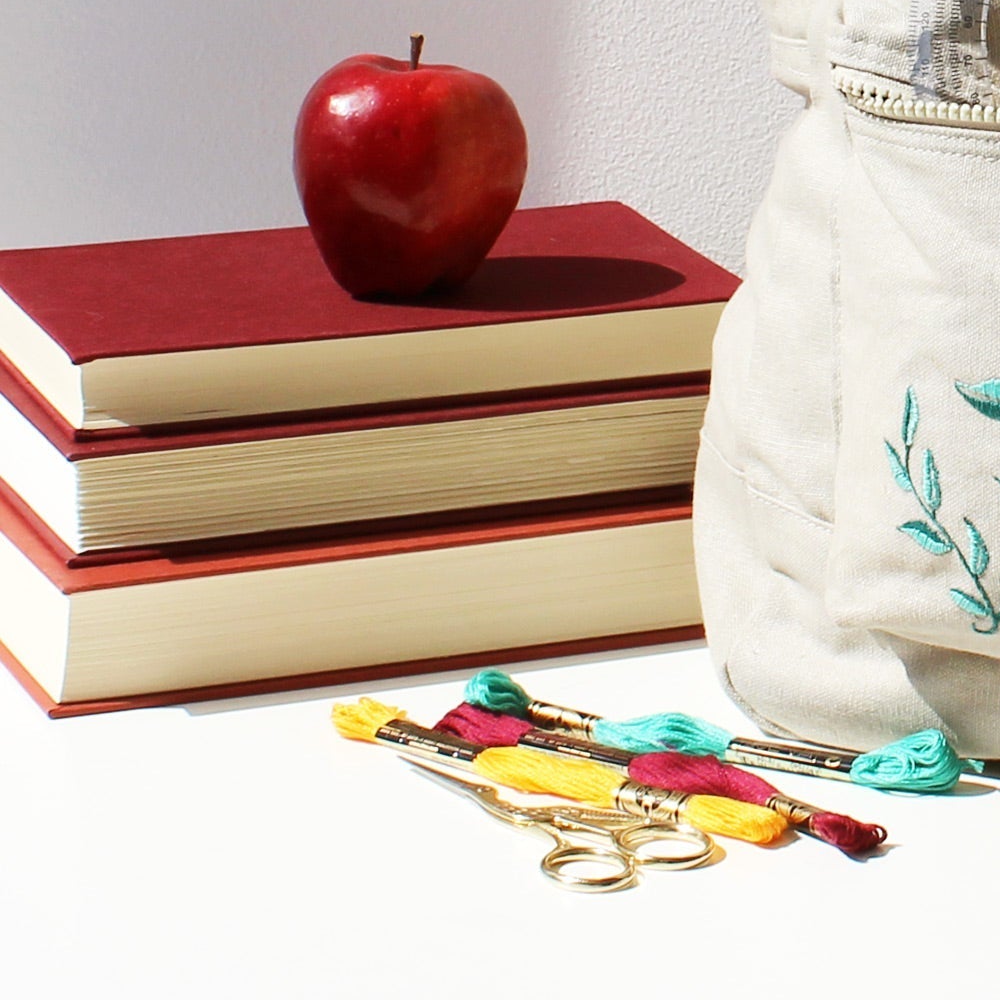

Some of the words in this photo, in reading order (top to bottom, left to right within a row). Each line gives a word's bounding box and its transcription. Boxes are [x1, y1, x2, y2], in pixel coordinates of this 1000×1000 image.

[920, 12, 930, 31] 120
[921, 59, 930, 76] 110
[963, 55, 973, 67] 70
